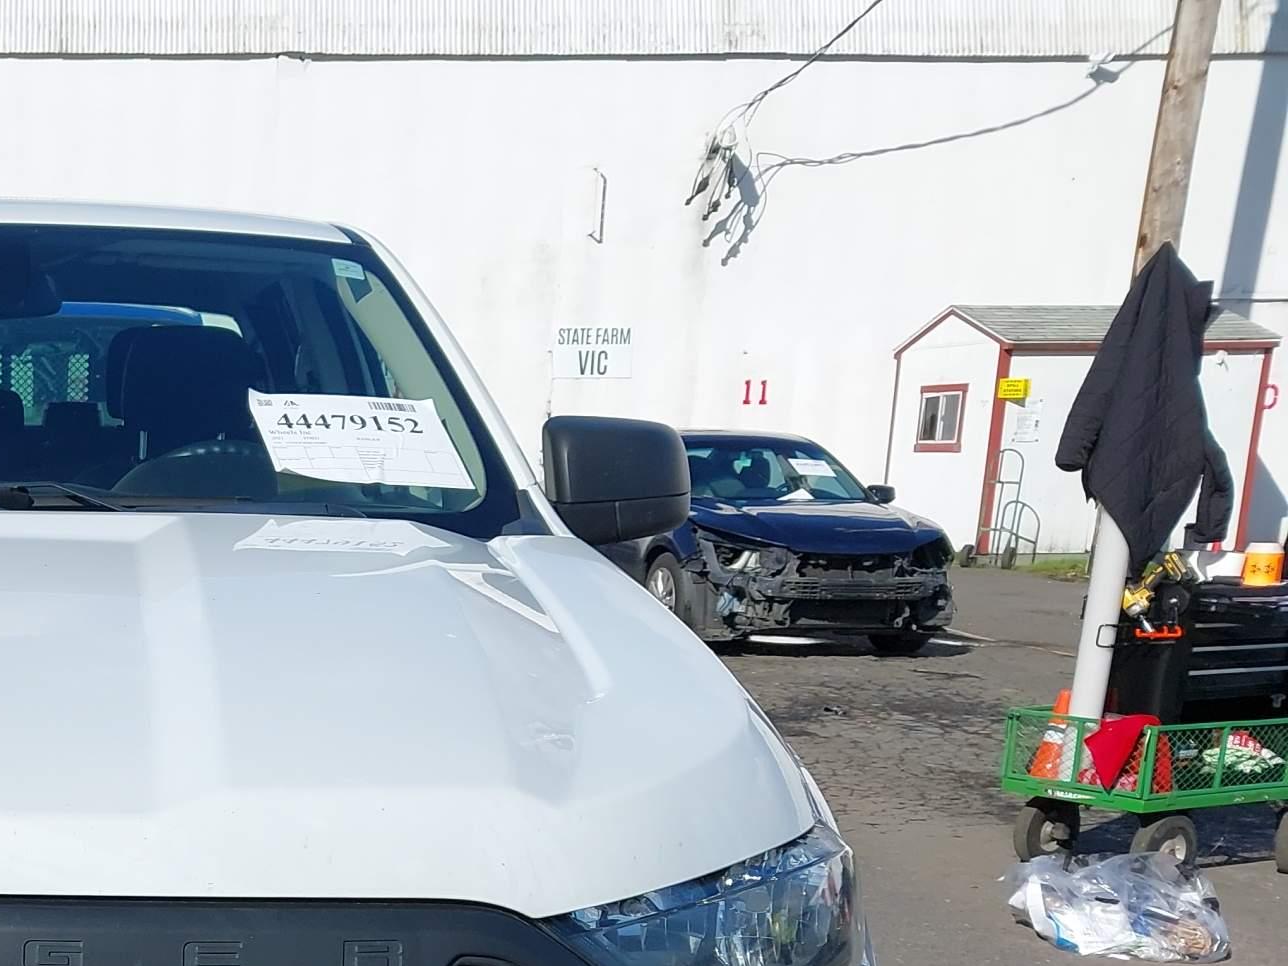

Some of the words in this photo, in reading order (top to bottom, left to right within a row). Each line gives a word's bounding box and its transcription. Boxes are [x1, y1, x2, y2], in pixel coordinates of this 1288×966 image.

[558, 328, 592, 345] STATE
[595, 328, 631, 345] FARM
[578, 350, 608, 376] VIC
[742, 379, 768, 405] 11
[277, 413, 424, 434] 44479152
